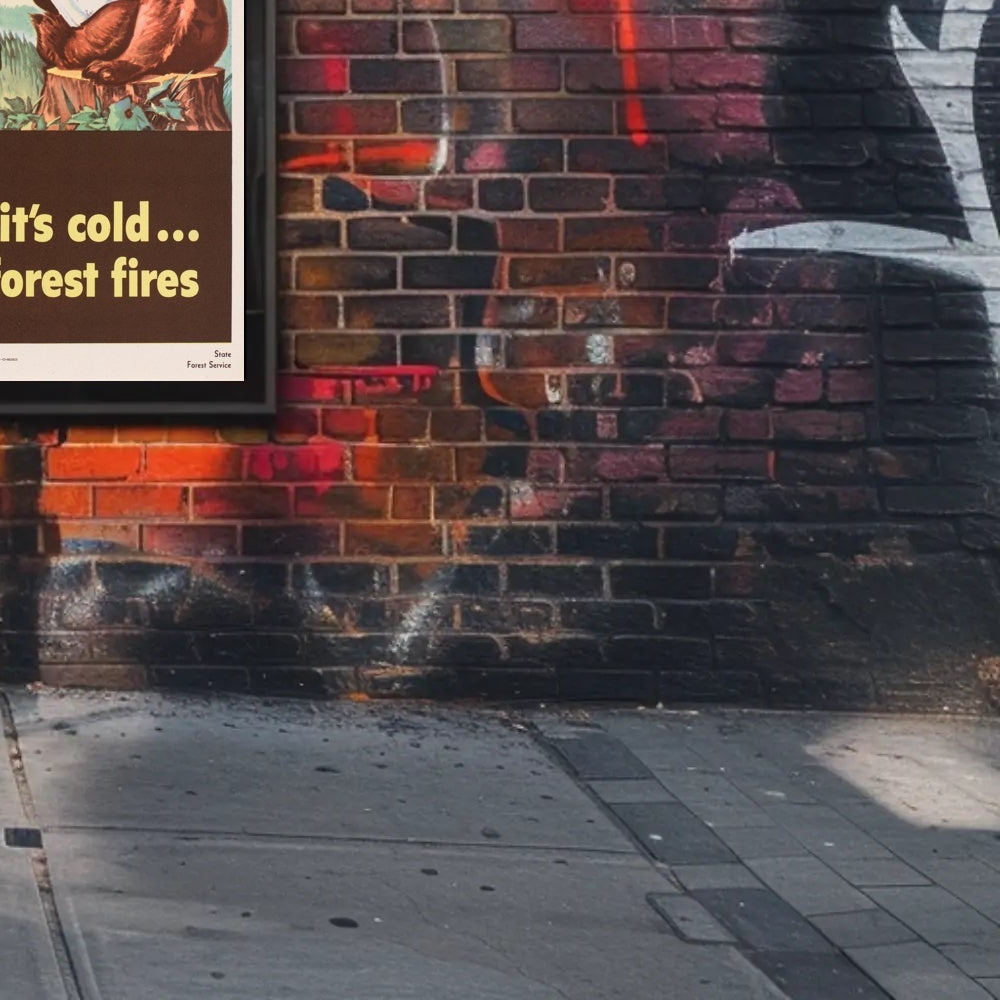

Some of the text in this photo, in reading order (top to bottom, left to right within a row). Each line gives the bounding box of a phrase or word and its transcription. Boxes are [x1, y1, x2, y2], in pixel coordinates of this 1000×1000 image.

[0, 201, 54, 243] it's
[111, 256, 200, 298] fires
[186, 360, 232, 369] Forest Service
[214, 349, 232, 358] State
